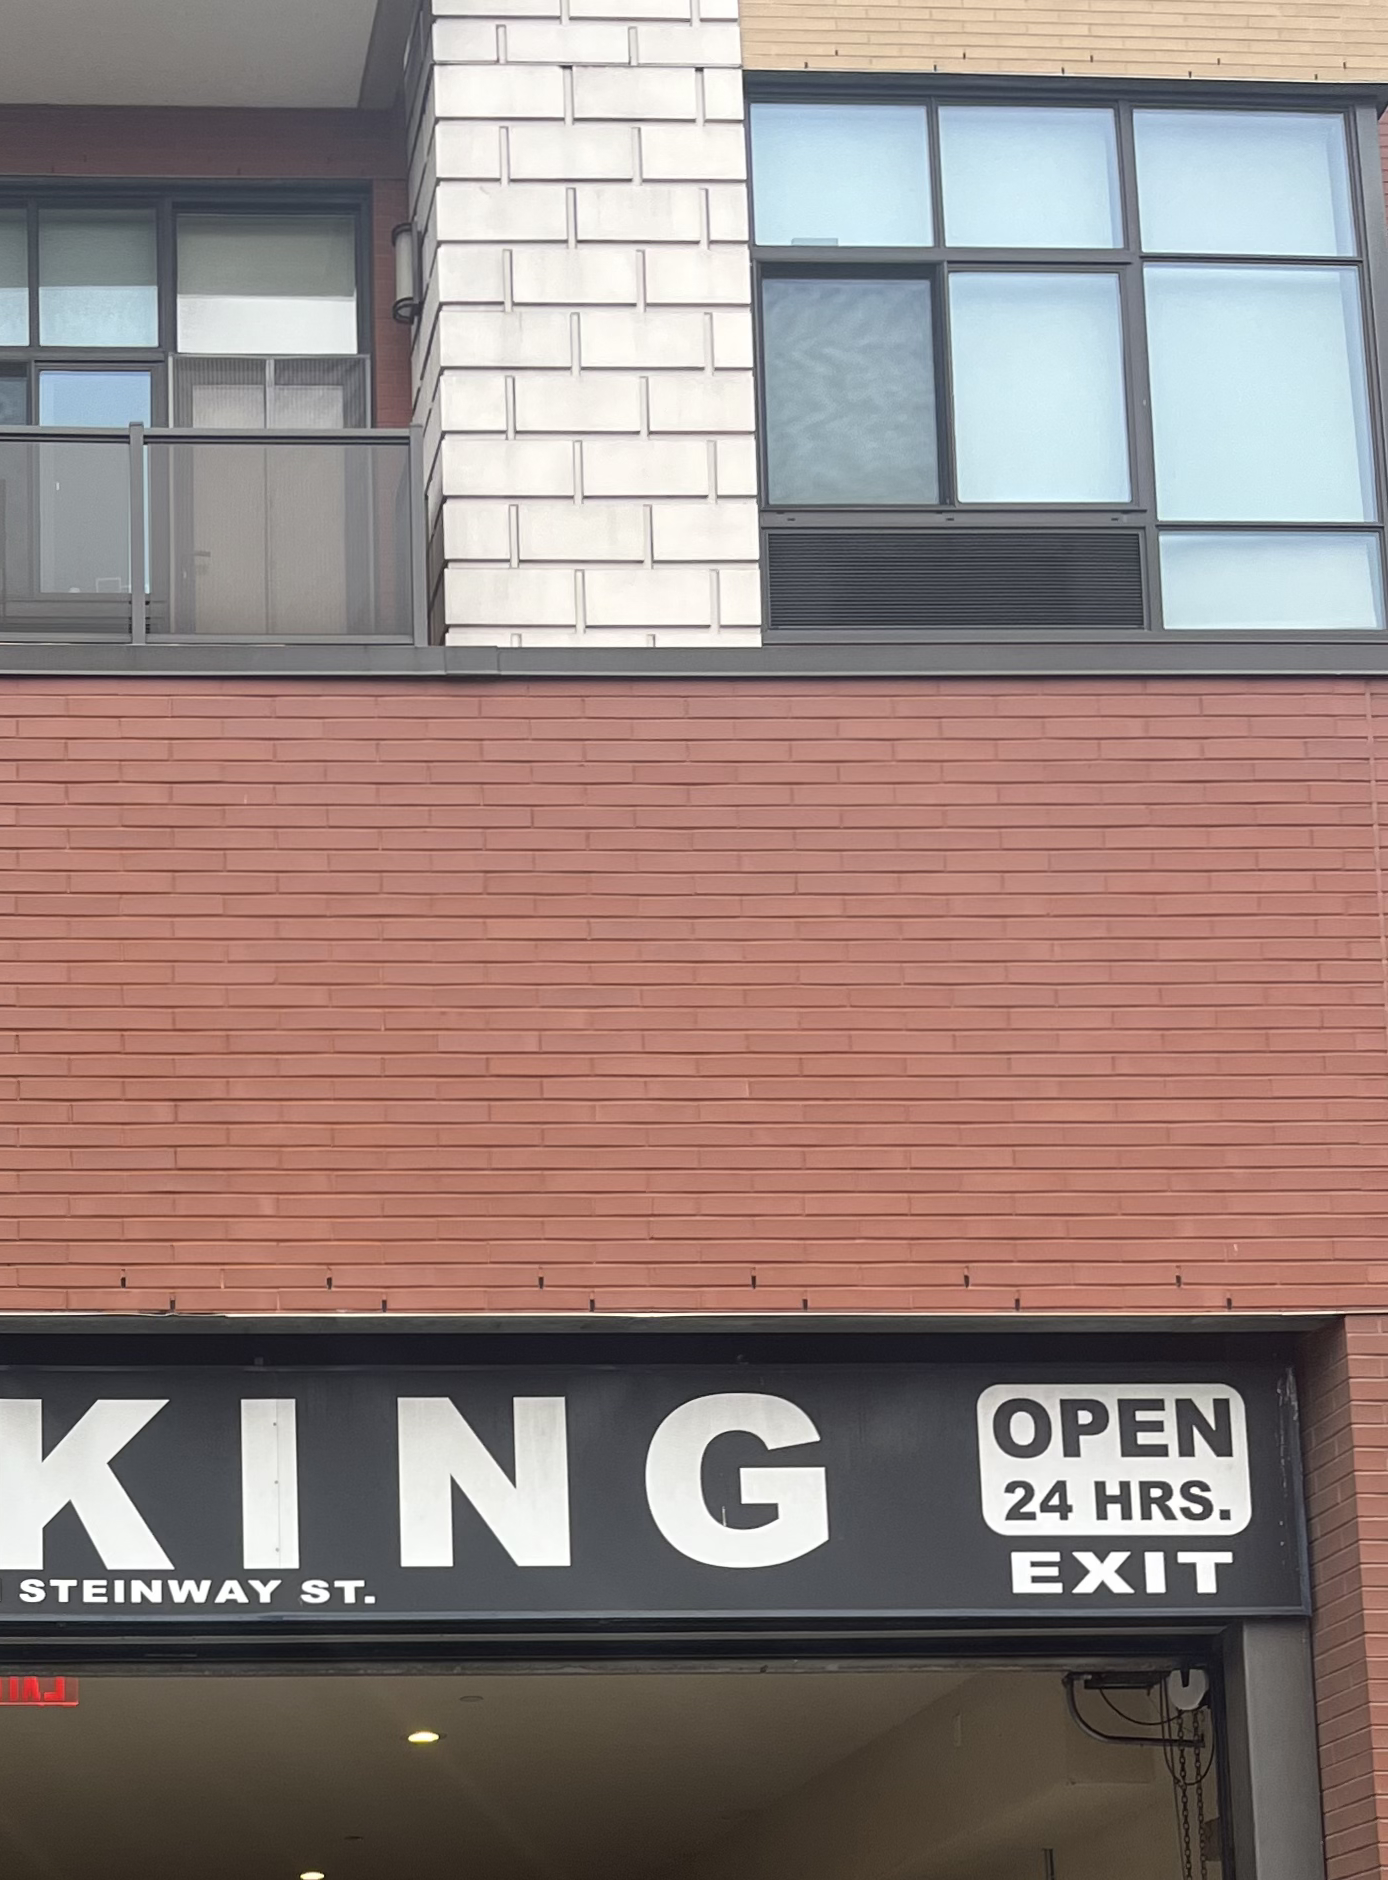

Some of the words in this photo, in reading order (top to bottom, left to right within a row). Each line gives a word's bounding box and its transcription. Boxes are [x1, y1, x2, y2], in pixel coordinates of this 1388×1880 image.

[992, 1397, 1234, 1460] OPEN
[1004, 1480, 1074, 1521] 24
[1094, 1480, 1232, 1522] HRS.
[19, 1578, 283, 1605] STEINWAY
[300, 1579, 377, 1605] ST.
[1011, 1551, 1234, 1595] EXIT
